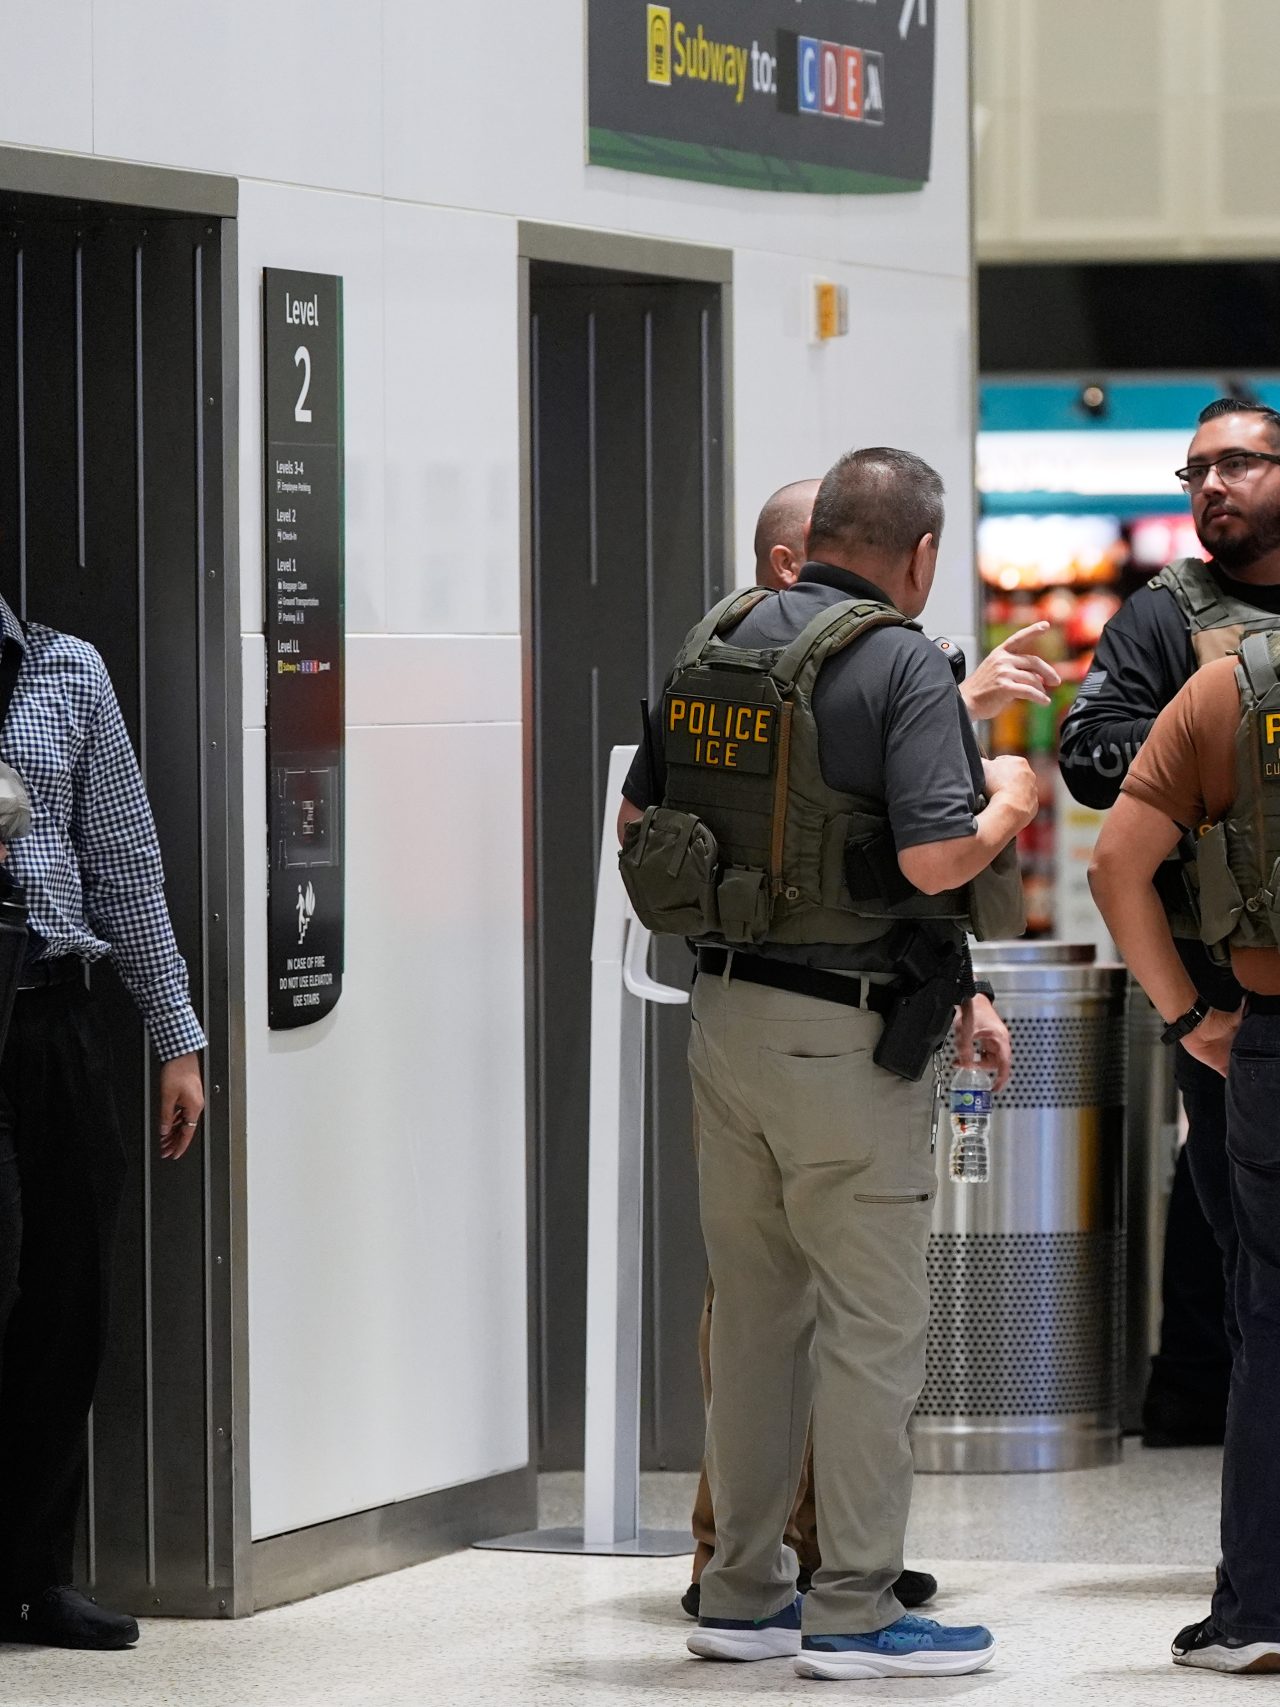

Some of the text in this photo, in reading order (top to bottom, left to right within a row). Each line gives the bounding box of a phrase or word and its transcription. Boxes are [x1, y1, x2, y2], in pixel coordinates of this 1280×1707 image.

[673, 21, 748, 104] Subway
[751, 40, 777, 95] to:
[285, 292, 319, 327] Level
[294, 345, 312, 423] 2
[276, 460, 304, 475] Levels 3-4
[276, 508, 296, 522] Level 2
[277, 558, 297, 572] Level 1
[277, 639, 300, 653] Level LL
[669, 699, 771, 743] POLICE
[695, 738, 739, 767] ICE
[287, 955, 326, 971] IN CASE OF FIRE
[279, 973, 333, 990] DO NOT USE ELEVATOR
[293, 992, 320, 1007] USE STAIRS
